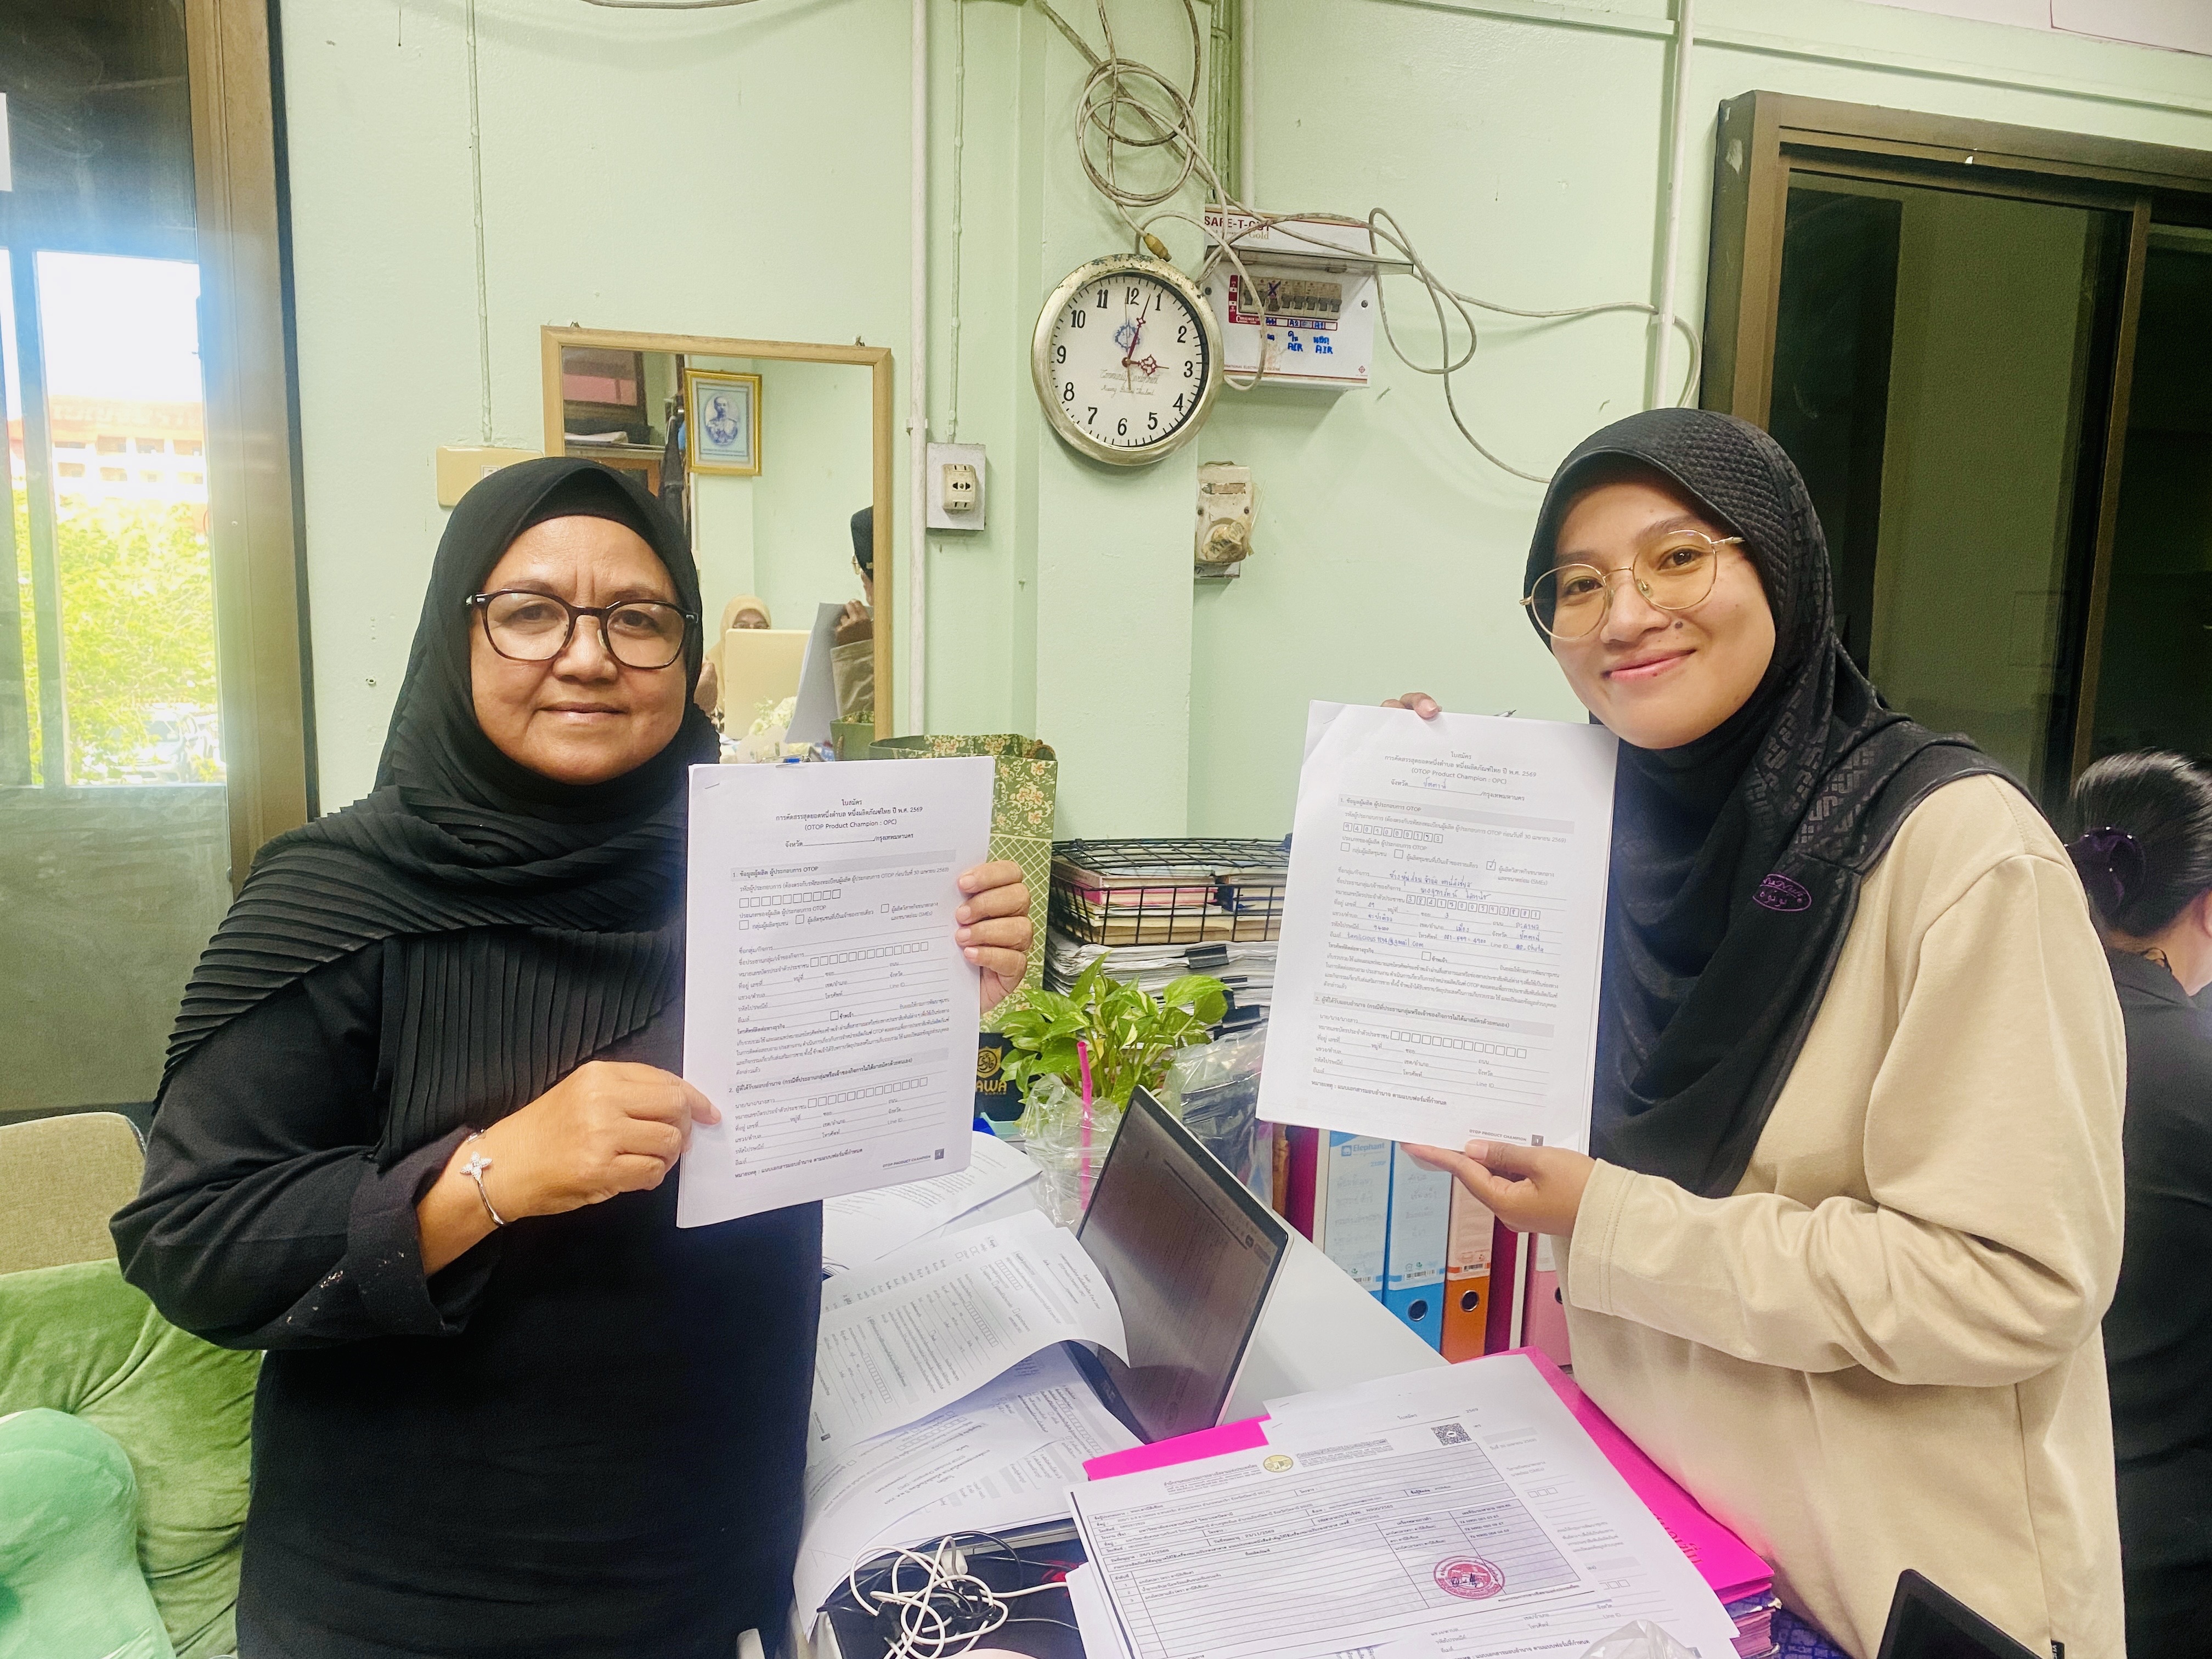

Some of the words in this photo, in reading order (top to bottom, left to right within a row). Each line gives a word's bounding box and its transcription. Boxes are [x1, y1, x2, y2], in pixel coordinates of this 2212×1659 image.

[1249, 231, 1269, 240] Gold
[1097, 290, 1109, 308] 11
[1126, 287, 1139, 305] 12
[1155, 294, 1161, 311] 1
[1071, 311, 1085, 328] 10
[1177, 326, 1187, 343] 2
[1288, 342, 1303, 352] AIR
[1316, 345, 1333, 354] AIR
[1057, 348, 1066, 363] 9
[1184, 360, 1193, 377] 3
[1064, 383, 1074, 401] 8
[1173, 393, 1183, 411] 4
[1088, 408, 1097, 424] 7
[1148, 413, 1158, 429] 5
[1118, 419, 1127, 435] 6
[1451, 751, 1471, 759] ใบสมัคร
[1456, 773, 1487, 782] Champion
[842, 798, 862, 806] ใบสมัคร
[776, 809, 845, 822] การคัดสรรสุดยอดหนึ่งตำบล
[977, 1080, 1007, 1092] AWA
[1353, 1143, 1385, 1152] Elephant
